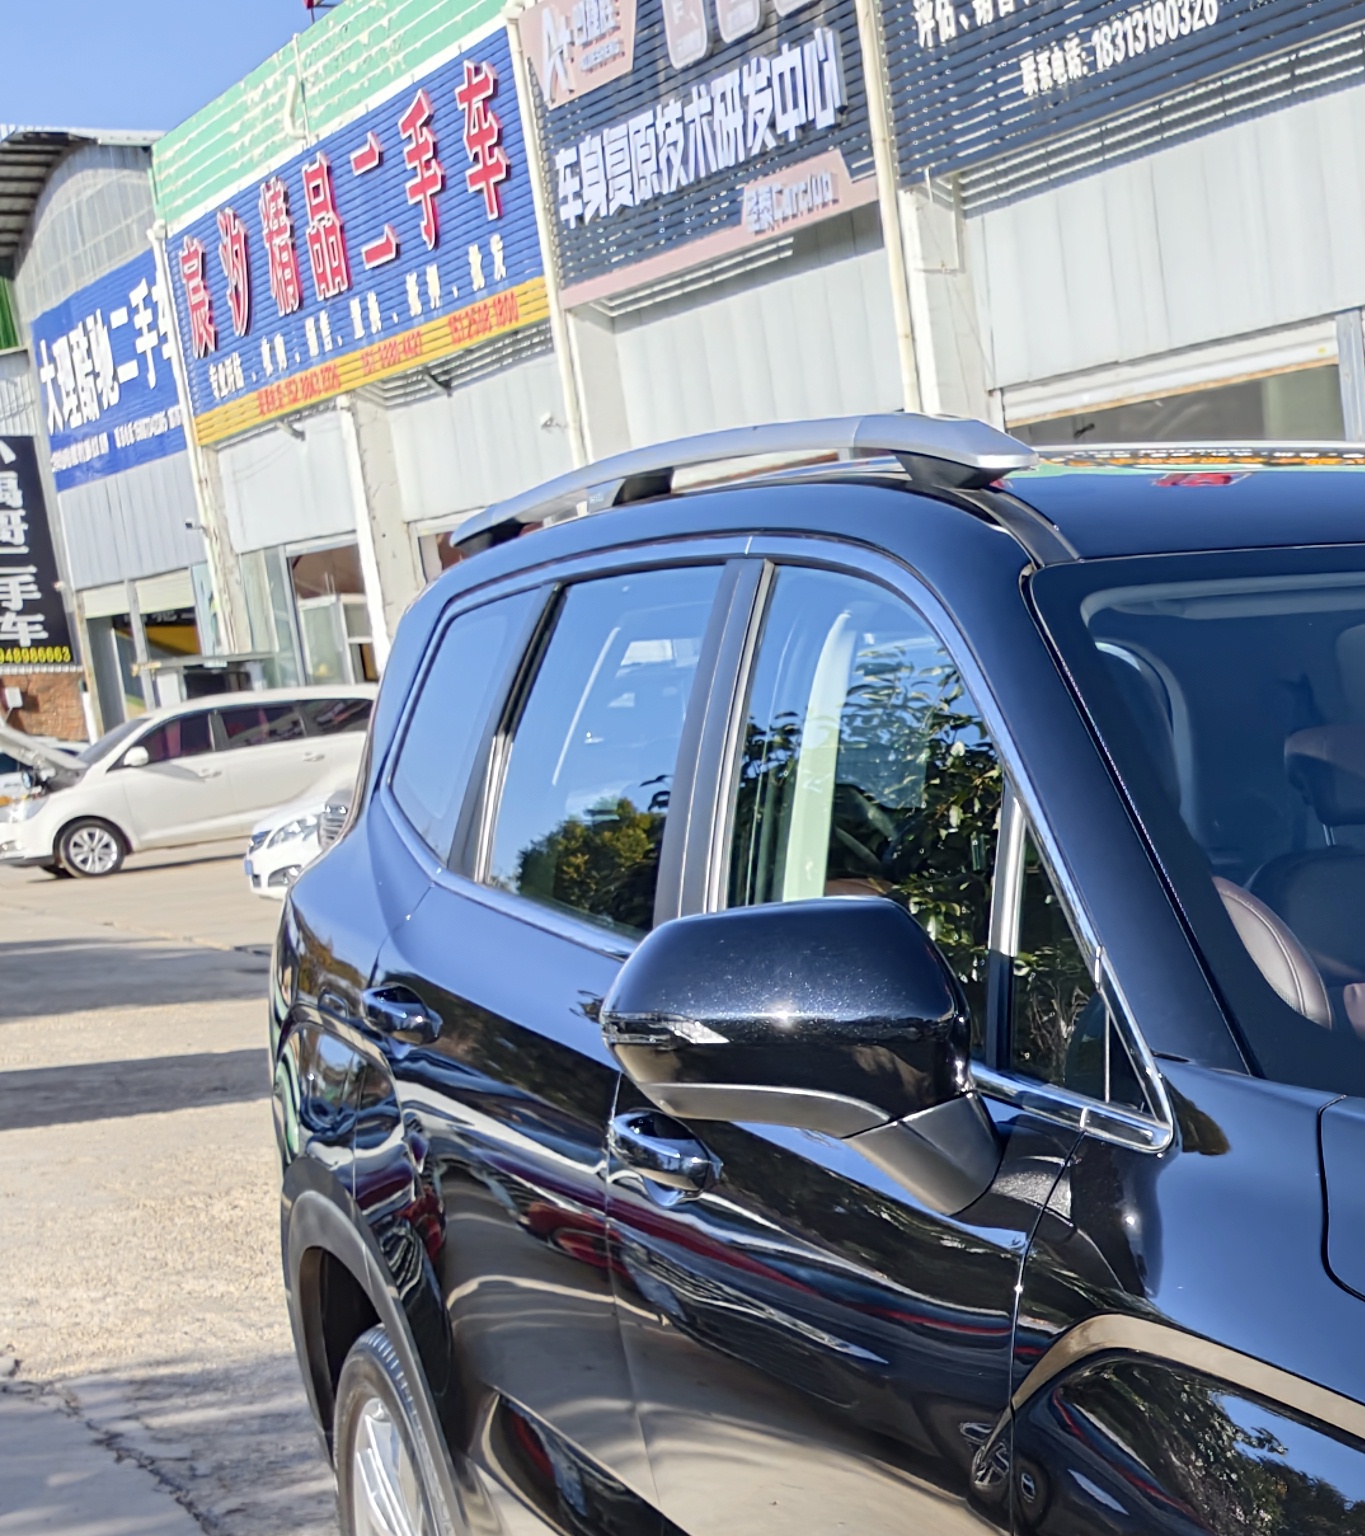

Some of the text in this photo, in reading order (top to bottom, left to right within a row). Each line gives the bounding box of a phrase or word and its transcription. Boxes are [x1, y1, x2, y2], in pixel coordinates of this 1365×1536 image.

[555, 27, 845, 229] 车身复原技术研发中心
